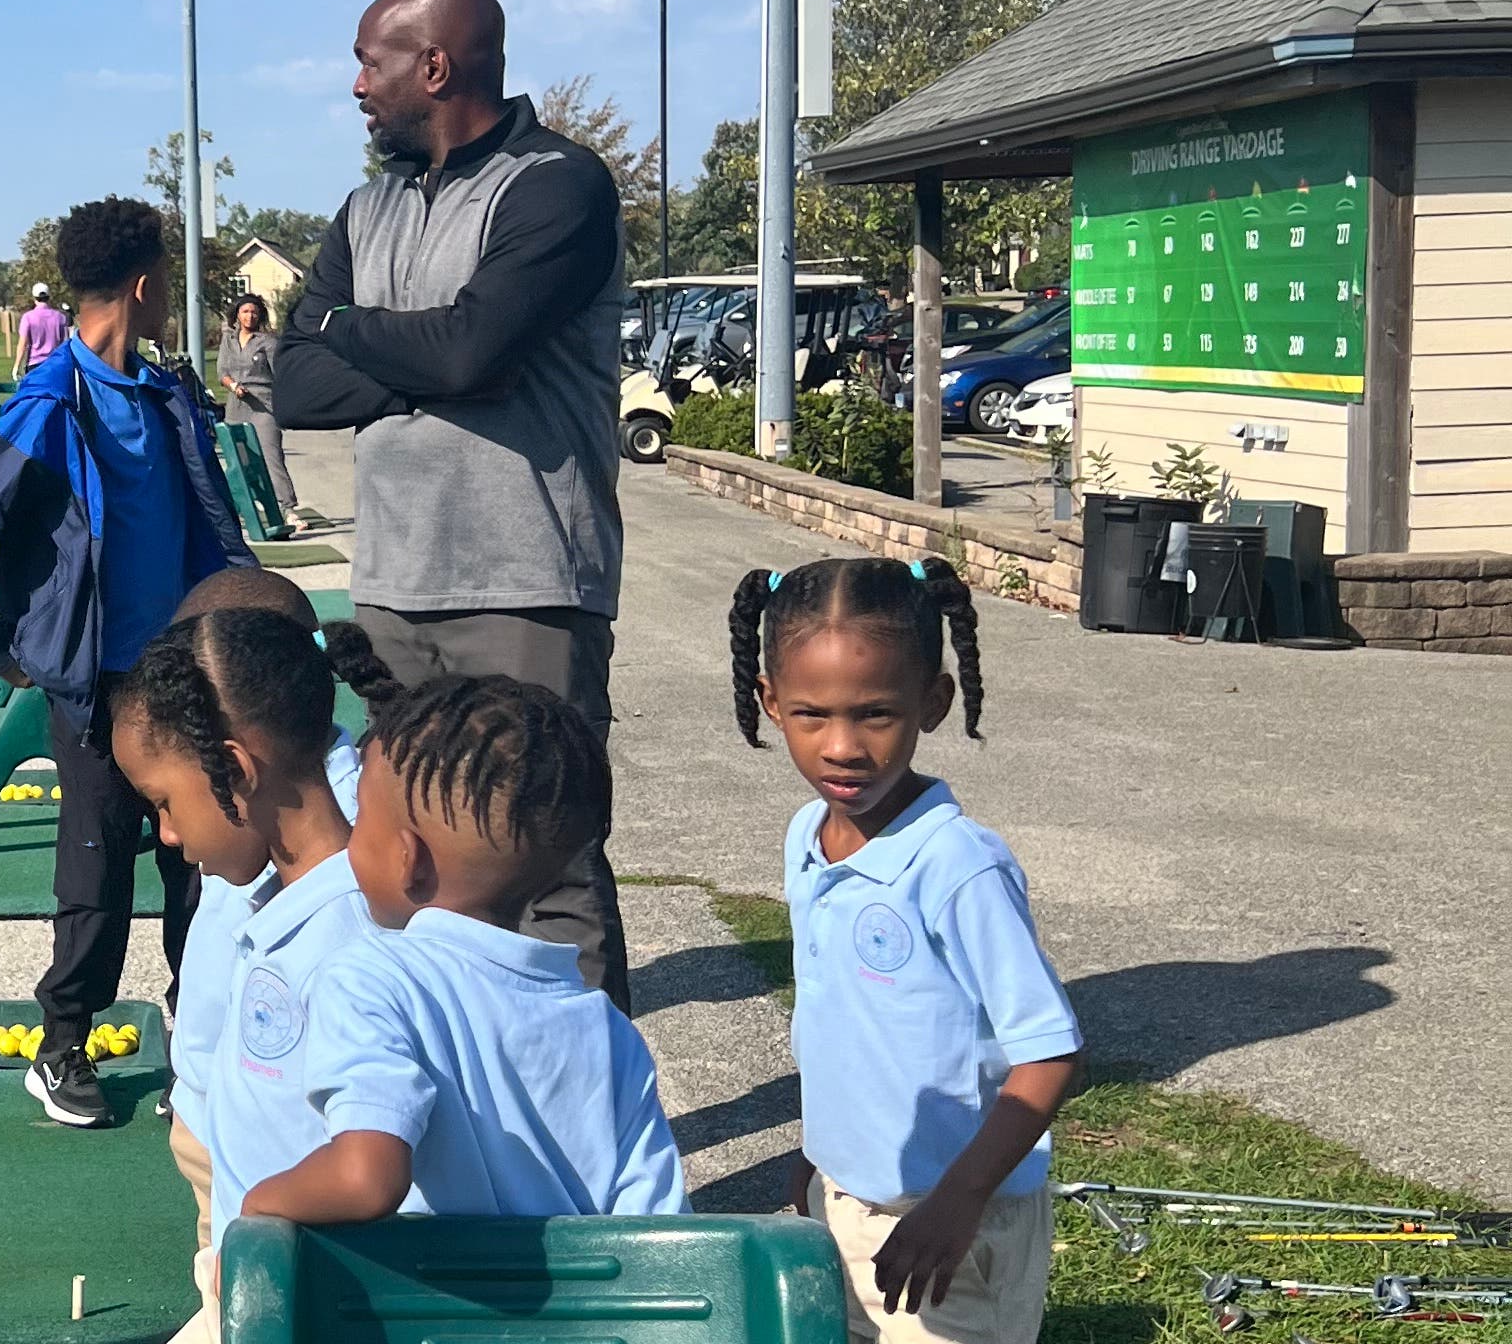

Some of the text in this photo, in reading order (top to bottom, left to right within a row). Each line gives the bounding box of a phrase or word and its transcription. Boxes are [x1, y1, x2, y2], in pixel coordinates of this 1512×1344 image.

[1131, 143, 1178, 176] DRIVING
[1180, 136, 1221, 168] RANGE
[1223, 127, 1285, 162] YARDAGE
[1290, 226, 1305, 248] 227
[1105, 287, 1117, 304] TEE
[1289, 281, 1305, 301] 214
[1105, 333, 1117, 351] TEE
[1289, 336, 1304, 356] 200
